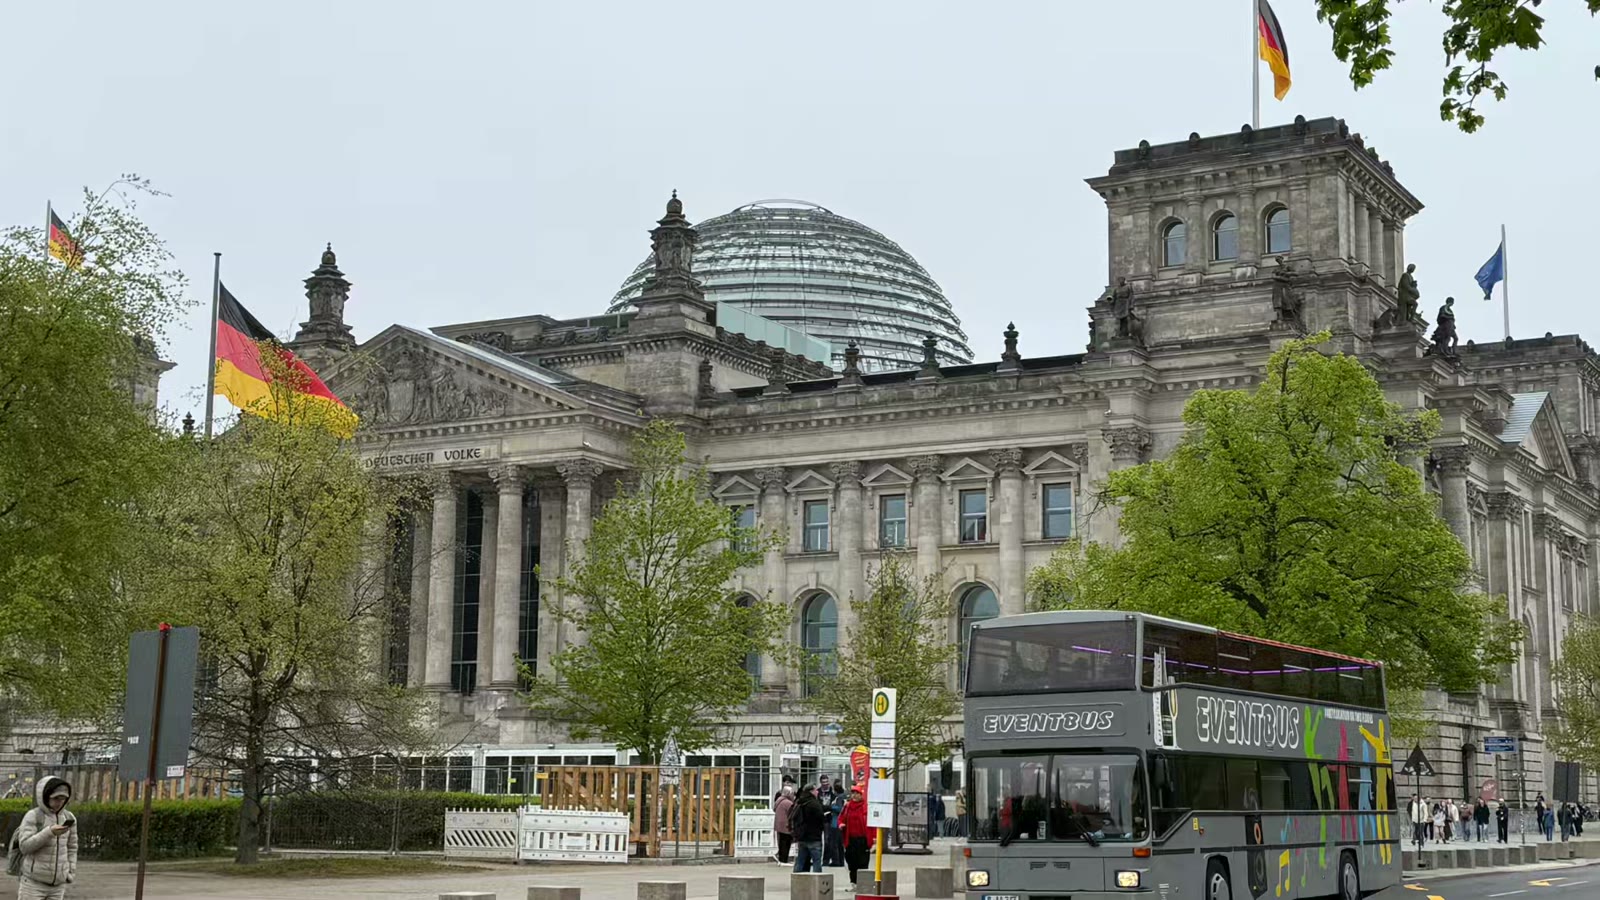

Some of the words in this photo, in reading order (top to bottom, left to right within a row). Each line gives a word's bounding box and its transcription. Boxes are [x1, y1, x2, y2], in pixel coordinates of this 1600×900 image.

[365, 452, 434, 468] DEUTSCHEN
[444, 448, 481, 461] VOLKE
[877, 697, 885, 712] H
[984, 710, 1114, 733] EVENTBUS
[1196, 696, 1299, 748] EVENTBUS
